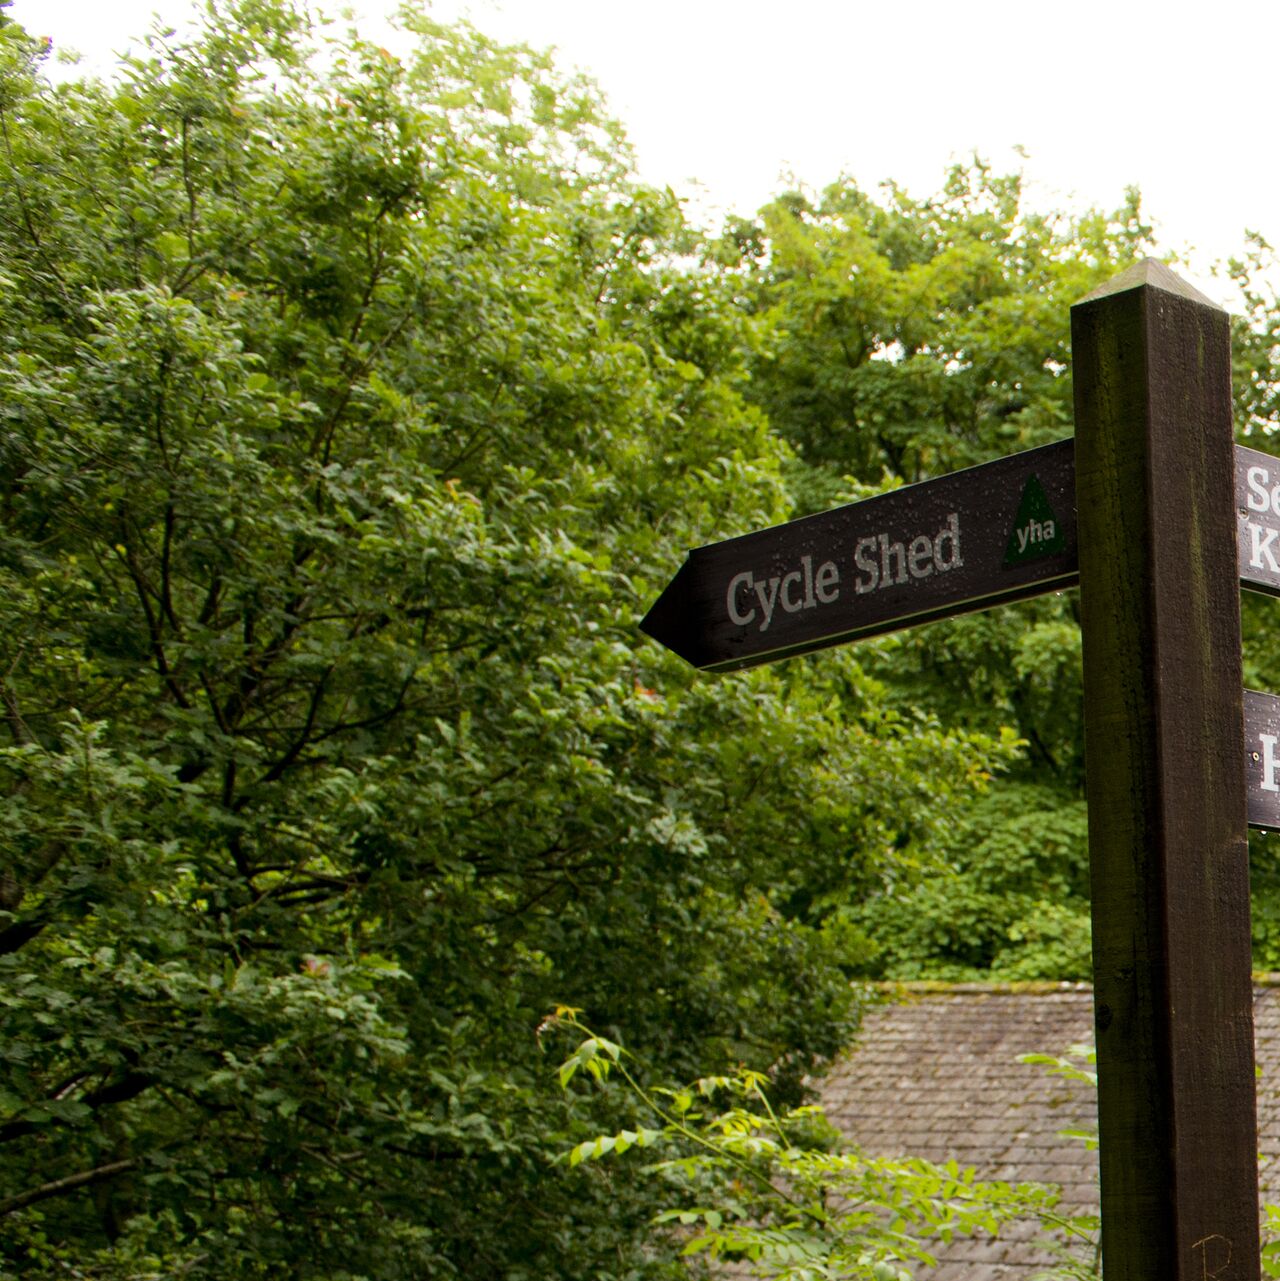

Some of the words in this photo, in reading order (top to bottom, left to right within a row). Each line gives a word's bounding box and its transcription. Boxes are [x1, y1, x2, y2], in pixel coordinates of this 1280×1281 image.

[726, 555, 838, 630] Cycle
[854, 513, 963, 594] Shed
[1017, 516, 1055, 552] yha
